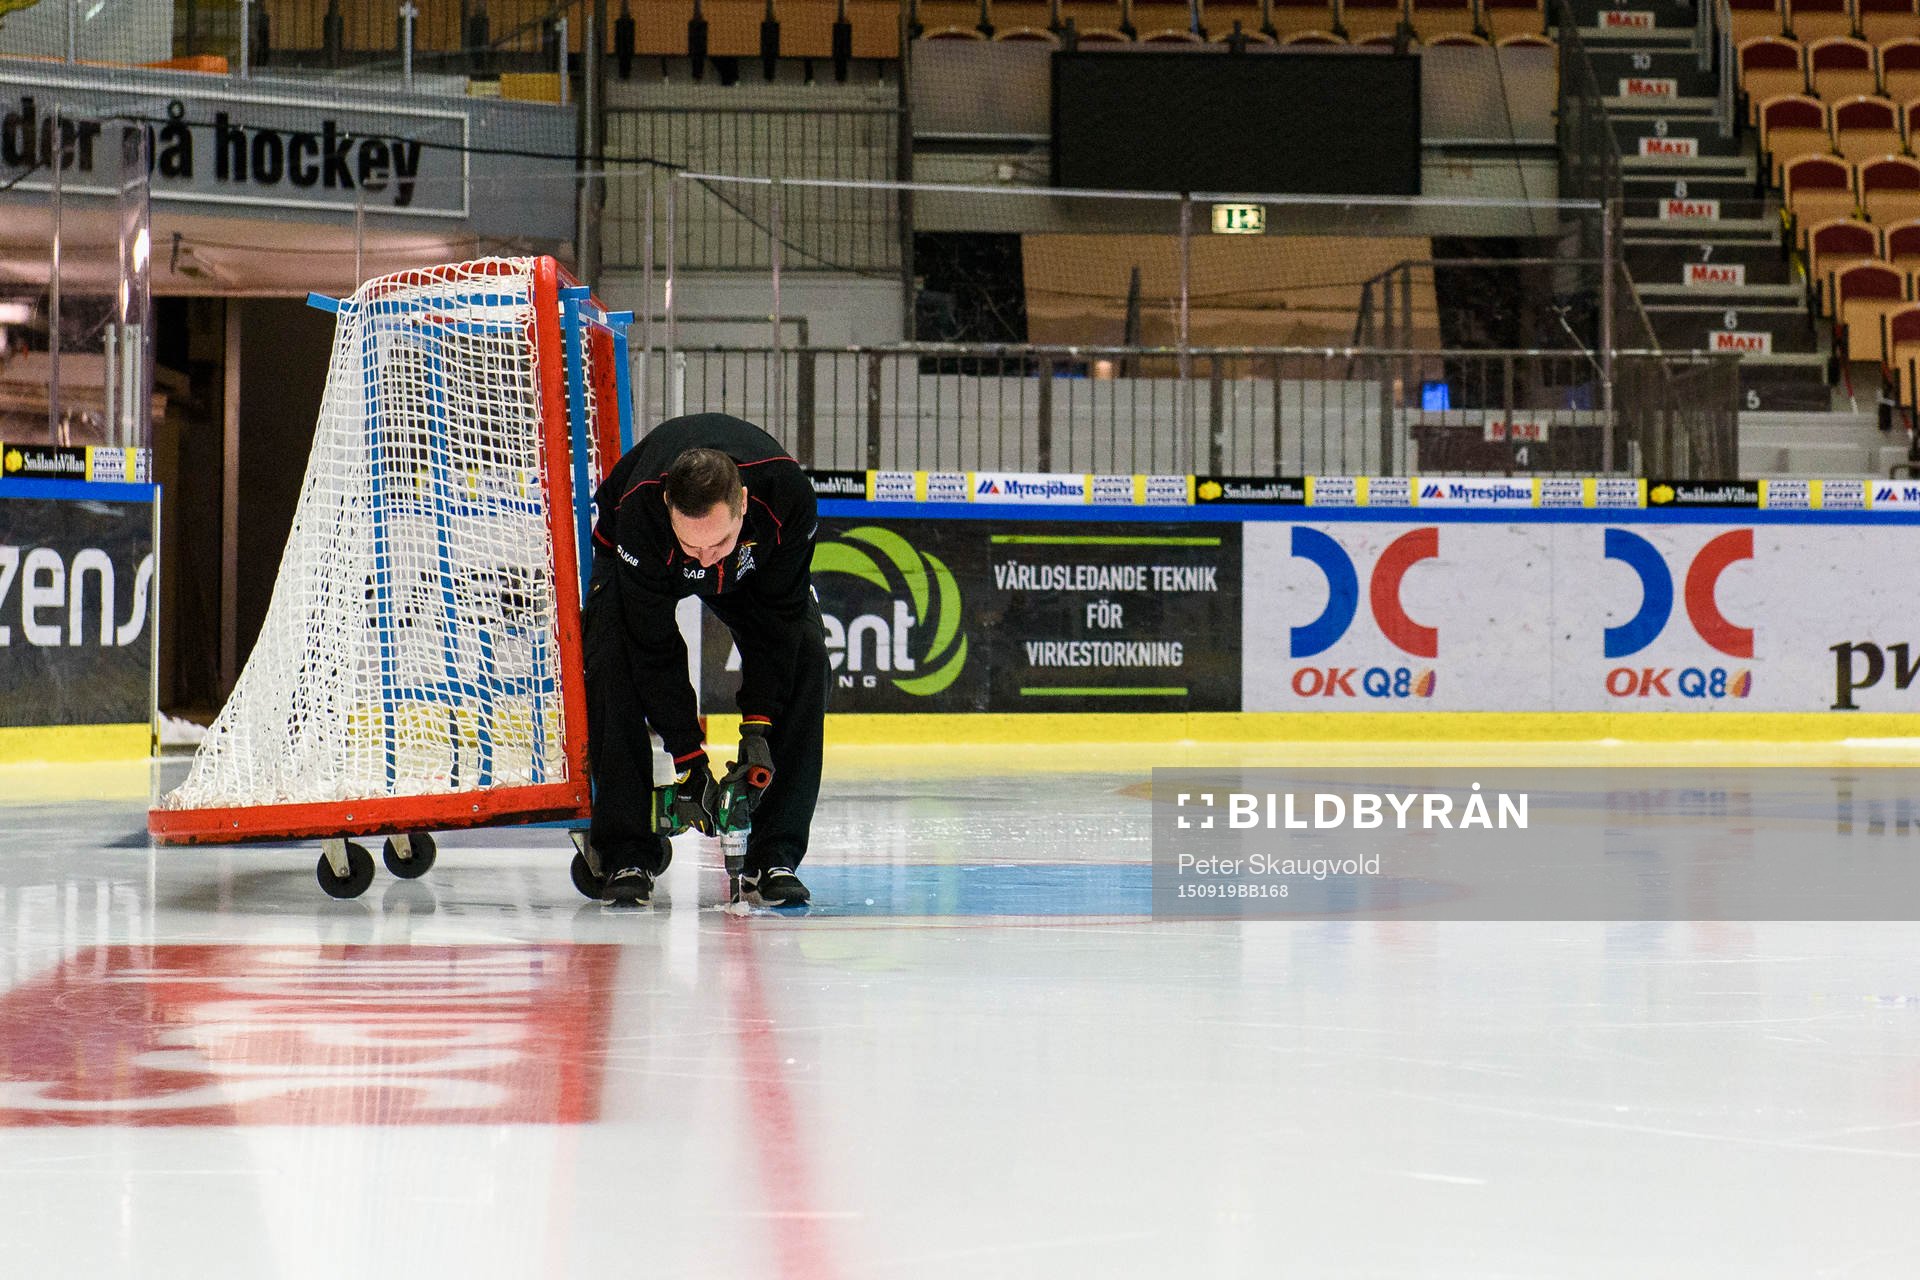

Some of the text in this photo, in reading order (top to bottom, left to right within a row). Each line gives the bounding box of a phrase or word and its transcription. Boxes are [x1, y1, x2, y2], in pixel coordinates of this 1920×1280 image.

[215, 112, 421, 207] hockey
[1701, 245, 1713, 262] 7
[1724, 309, 1737, 329] 6
[1516, 447, 1528, 466] 4
[1004, 480, 1084, 499] Myresjöhus
[1450, 484, 1532, 502] Myresjöhus
[994, 560, 1218, 592] VÄRLDSLEDANDE TEKNIK
[1086, 600, 1123, 629] FÖR
[1026, 641, 1183, 667] VIRKESTORKNING
